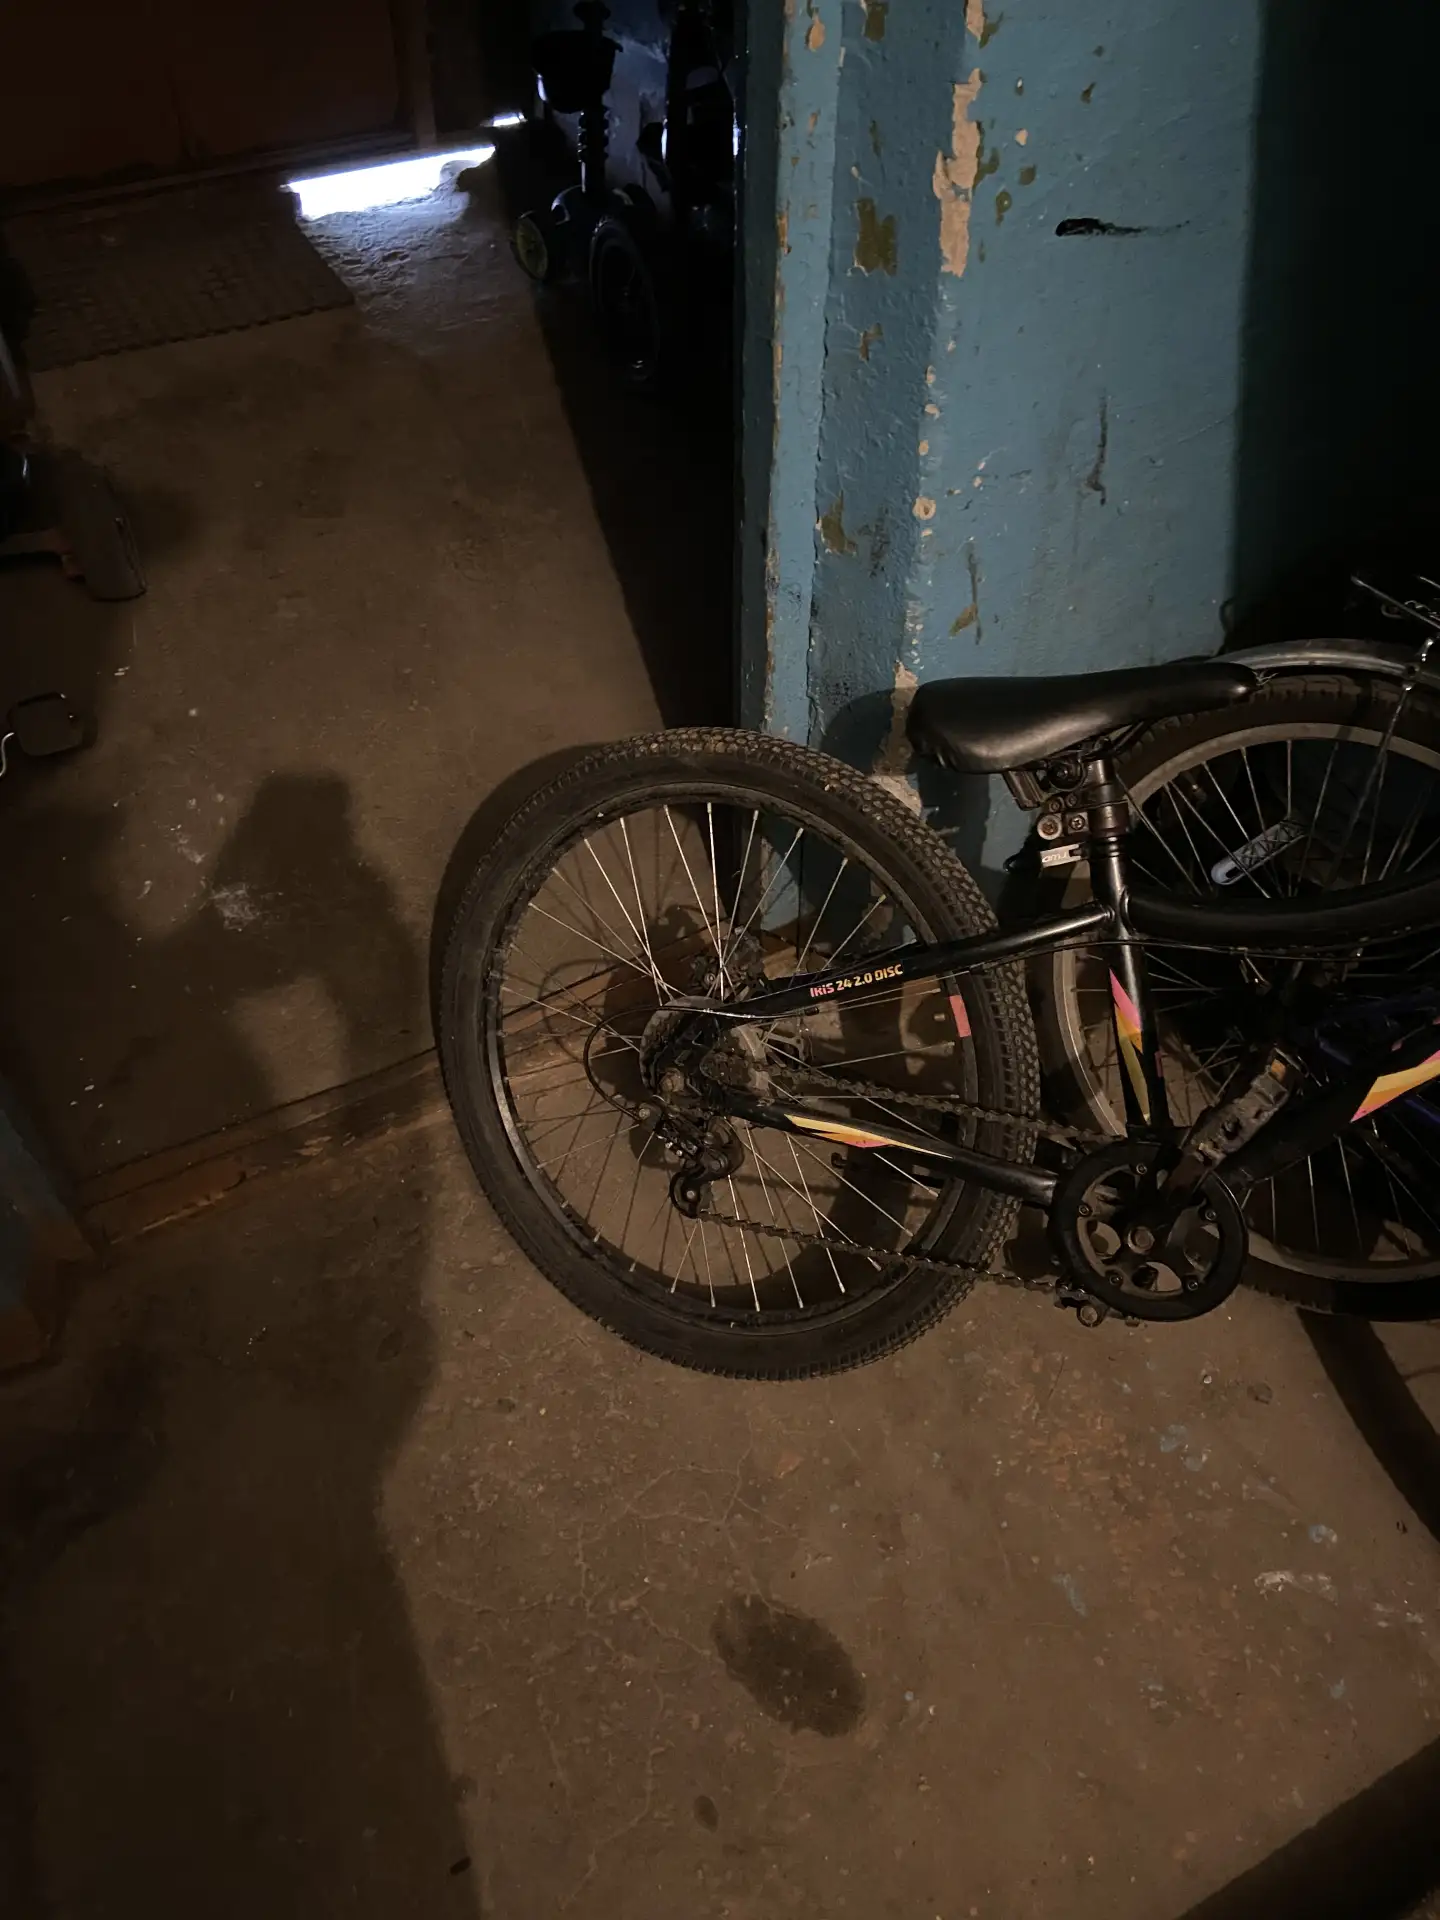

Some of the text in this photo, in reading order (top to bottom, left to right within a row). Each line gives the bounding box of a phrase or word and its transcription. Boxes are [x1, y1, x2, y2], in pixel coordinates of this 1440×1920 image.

[836, 979, 852, 991] 24
[854, 972, 873, 987] 2.0
[874, 964, 904, 981] DISC
